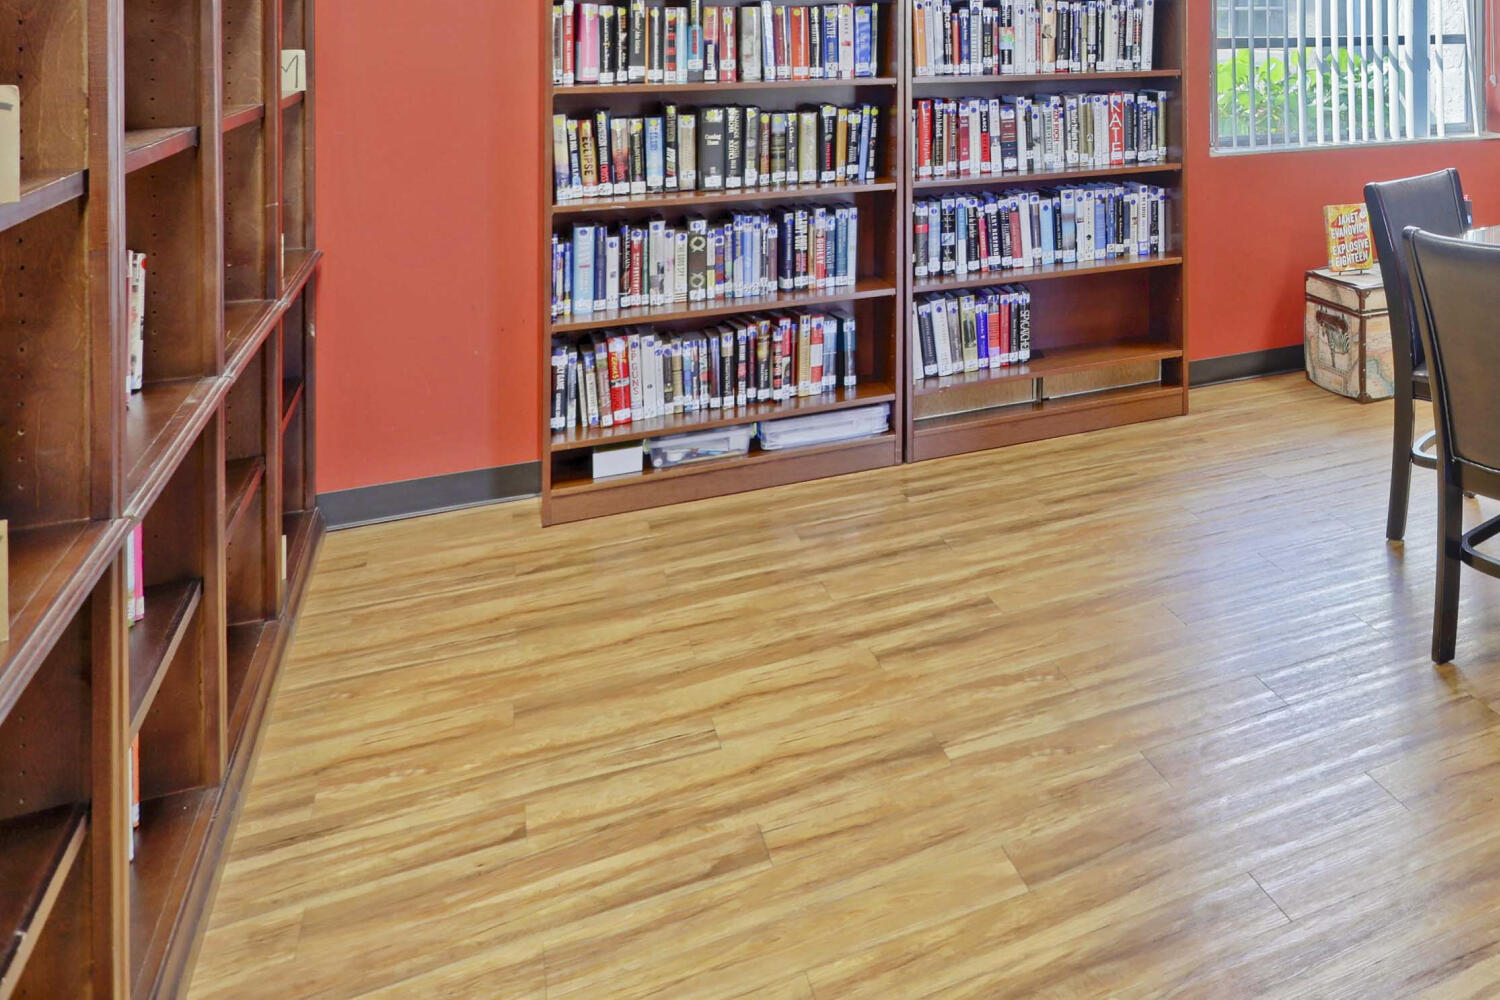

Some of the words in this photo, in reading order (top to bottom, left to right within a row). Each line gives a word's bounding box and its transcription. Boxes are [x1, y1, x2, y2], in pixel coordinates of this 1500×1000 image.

[582, 136, 594, 176] ECLIPSE
[1338, 212, 1359, 226] JANET
[1331, 222, 1367, 240] EVANOVICH
[1332, 238, 1369, 256] EXPLOSIVE
[1336, 250, 1368, 266] EIGHTEEN
